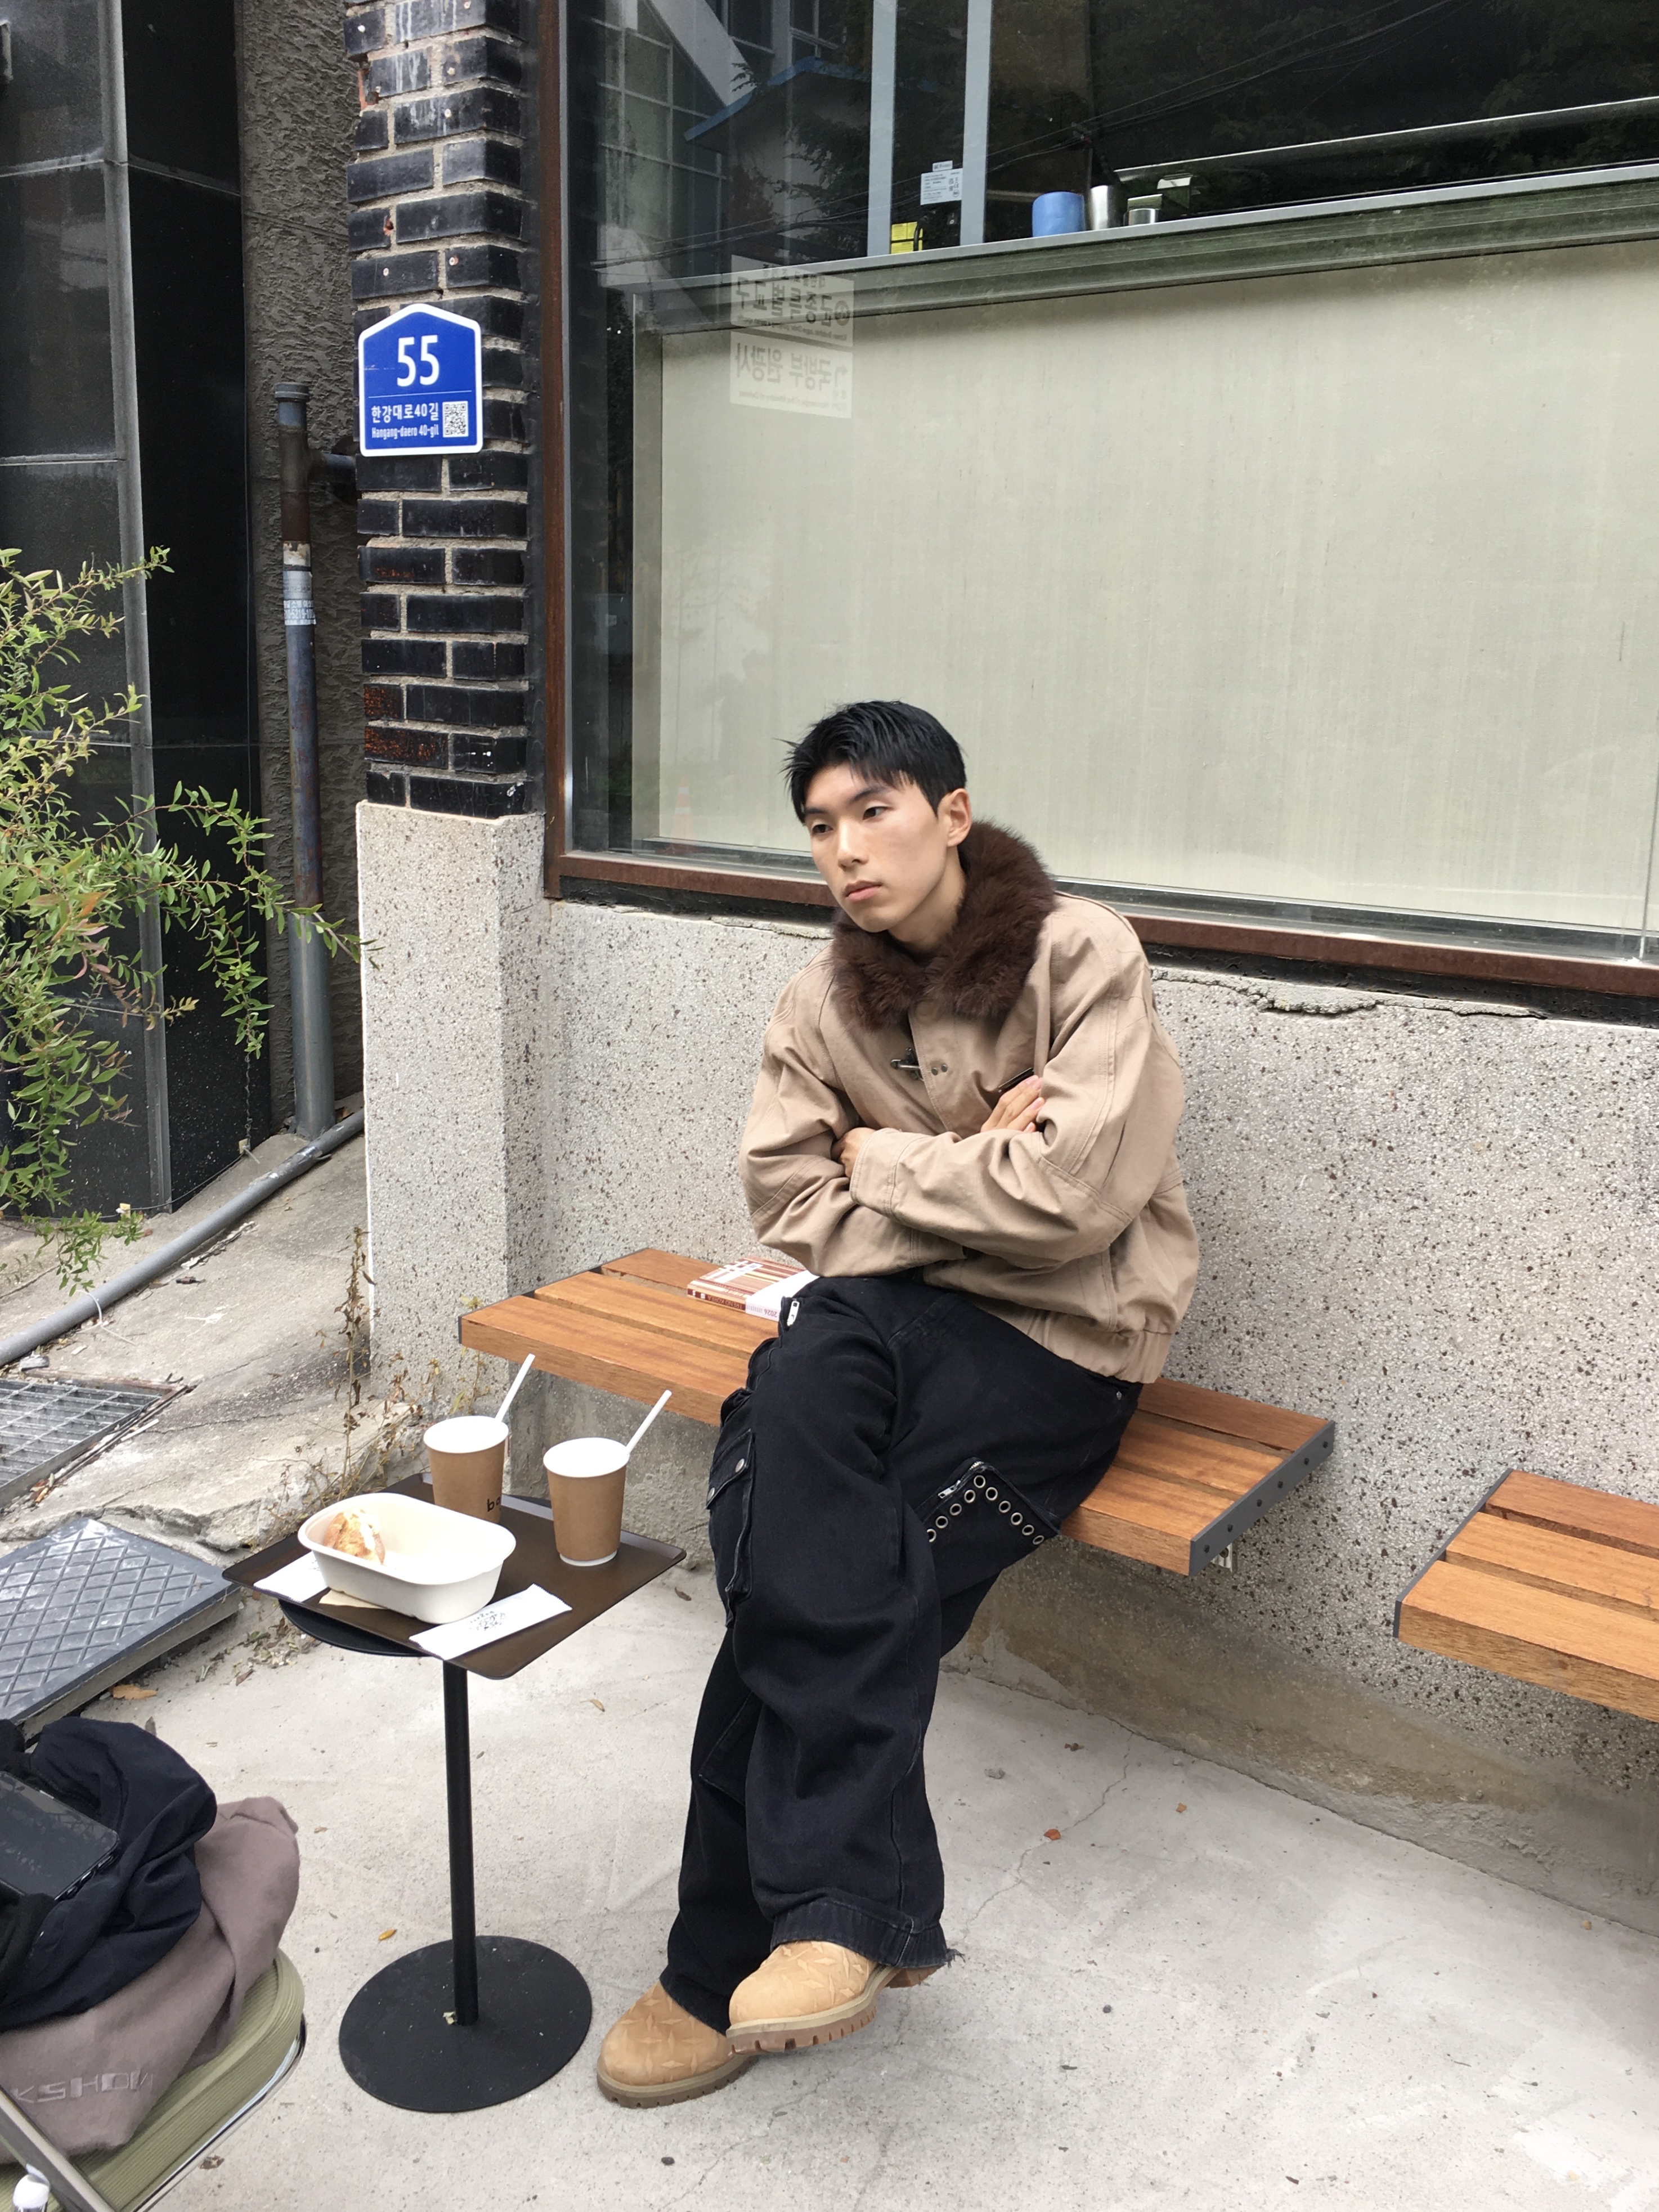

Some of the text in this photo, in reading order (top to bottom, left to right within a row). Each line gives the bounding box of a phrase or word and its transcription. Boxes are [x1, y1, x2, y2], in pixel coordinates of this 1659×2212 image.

[397, 334, 440, 387] 55
[371, 402, 439, 423] 한강대로40길
[371, 424, 439, 440] Hangang-daero 40-gil
[707, 1296, 724, 1304] KOREA
[725, 1300, 743, 1309] TREND
